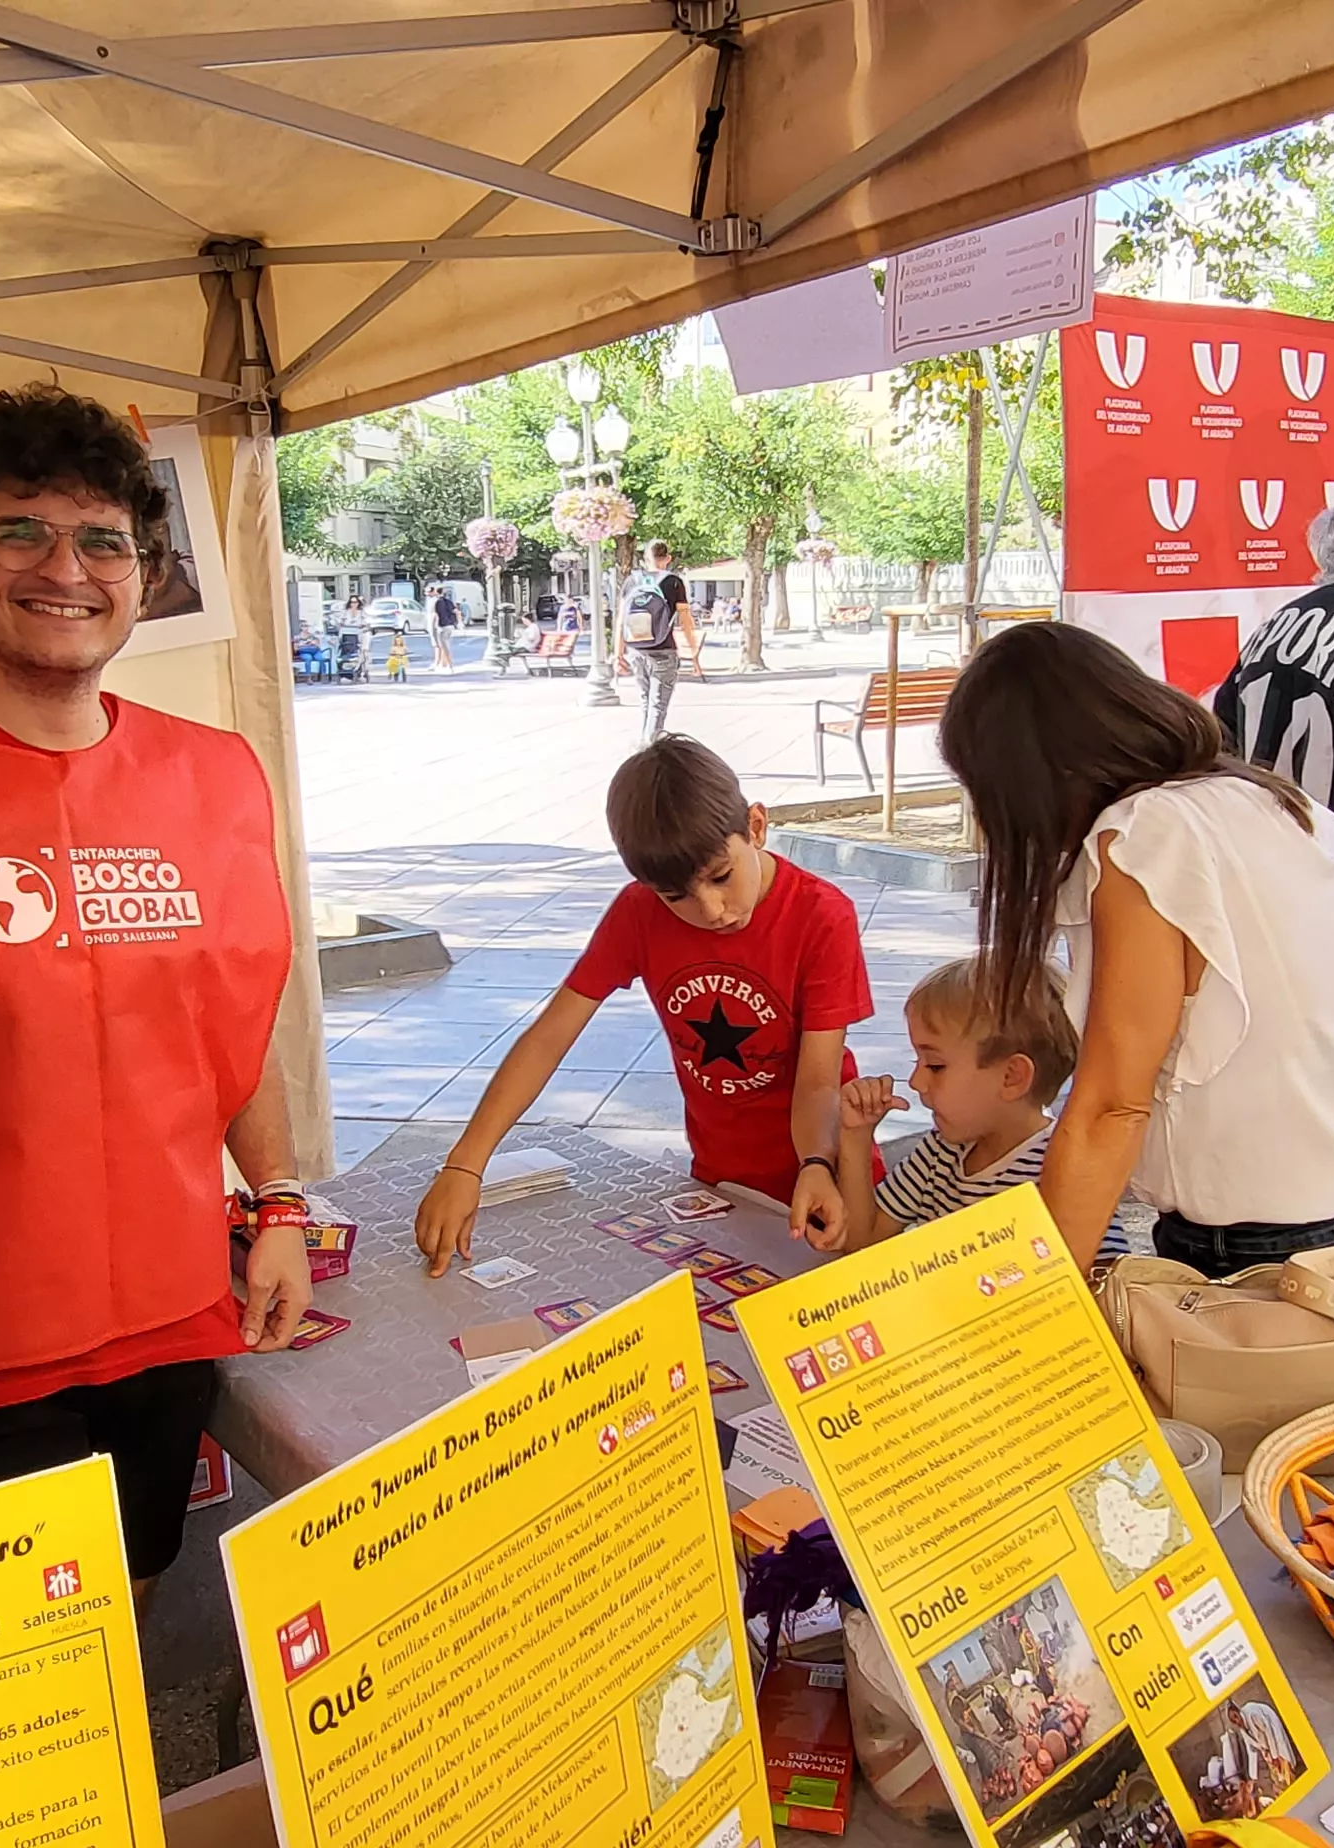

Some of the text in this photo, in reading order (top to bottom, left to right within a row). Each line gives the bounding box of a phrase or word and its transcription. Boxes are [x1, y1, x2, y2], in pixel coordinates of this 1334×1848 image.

[69, 848, 161, 860] ENTARACHEN
[71, 862, 181, 892] BOSCO
[82, 897, 196, 925] GLOBAL
[84, 931, 178, 945] ONGD SALESIANA
[667, 974, 778, 1025] CONVERSE
[683, 1059, 776, 1095] ALL STAR
[908, 1247, 960, 1284] juntas
[959, 1241, 980, 1259] en
[369, 1444, 439, 1511] Juvenil
[441, 1428, 481, 1462] Don
[483, 1393, 534, 1440] Bosco
[536, 1376, 557, 1404] de
[560, 1325, 645, 1390] Mekanissa:
[620, 1398, 654, 1430] BOSCO
[815, 1398, 865, 1442] Qué
[351, 1511, 429, 1573] Espacio
[431, 1491, 455, 1522] de
[458, 1433, 549, 1505] crecimiento
[550, 1424, 562, 1449] y
[21, 1593, 113, 1632] salesianos
[897, 1583, 971, 1641] Dónde
[1107, 1624, 1143, 1657] Con
[34, 1656, 47, 1675] y
[50, 1642, 100, 1666] supe-
[307, 1660, 376, 1737] Qué
[1133, 1664, 1181, 1711] quién
[36, 1724, 111, 1758] estudios
[788, 1752, 846, 1765] MARKERS
[767, 1759, 845, 1774] PERMANENT
[39, 1795, 80, 1822] para
[81, 1787, 99, 1804] la
